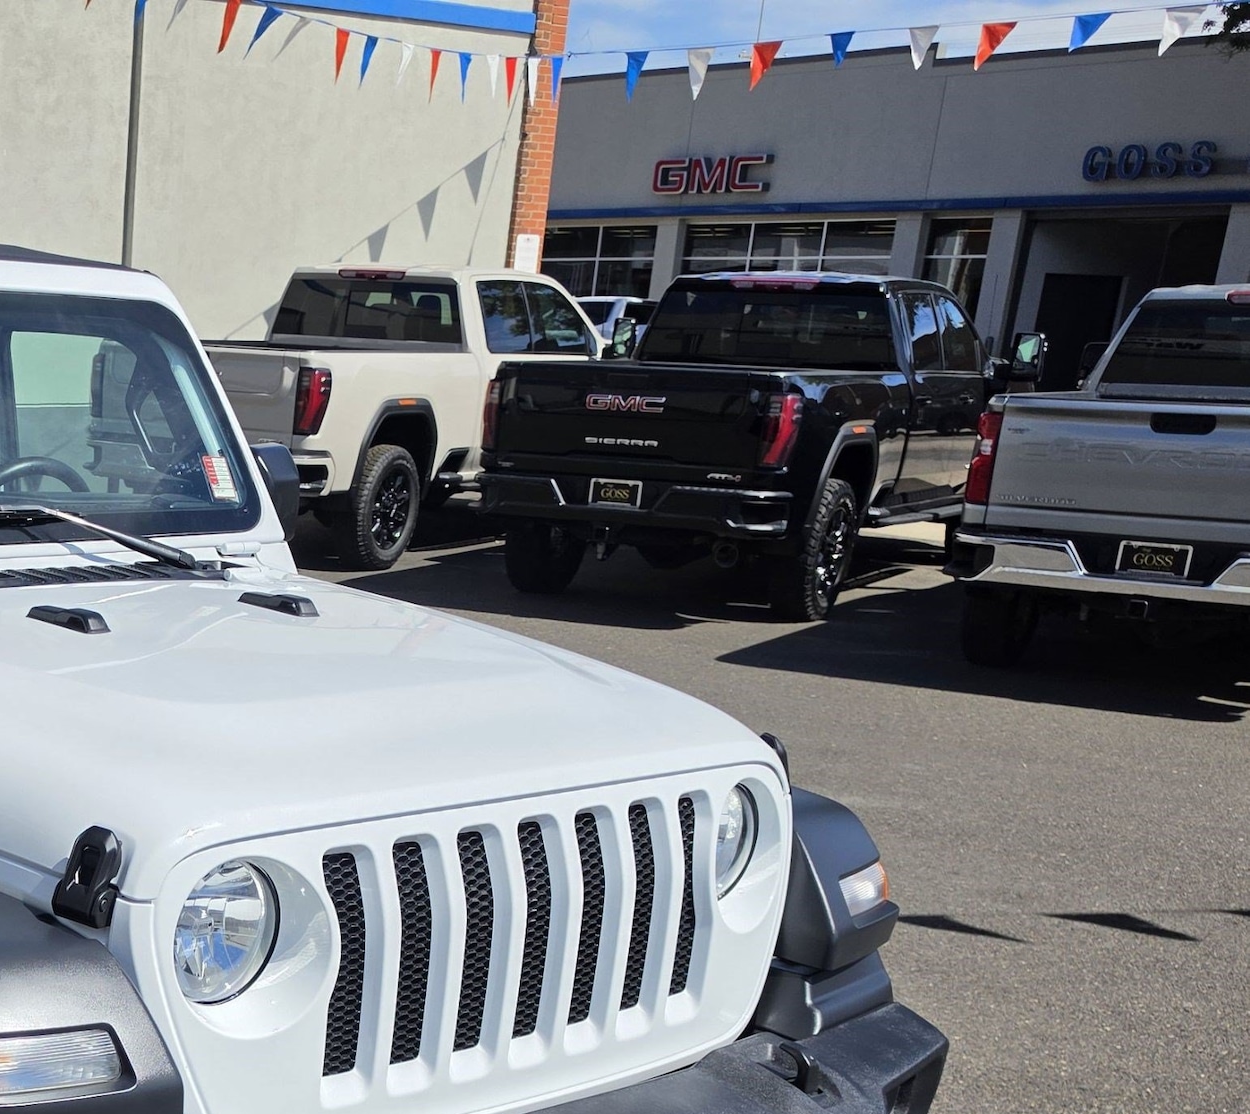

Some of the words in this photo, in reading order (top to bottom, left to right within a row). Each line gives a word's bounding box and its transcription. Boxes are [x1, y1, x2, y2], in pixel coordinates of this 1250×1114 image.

[1082, 140, 1217, 182] GOSS
[652, 153, 770, 195] GMC
[585, 393, 667, 413] GMC
[584, 436, 659, 448] SIERRA
[600, 487, 630, 500] GOSS
[1132, 552, 1174, 567] GOSS
